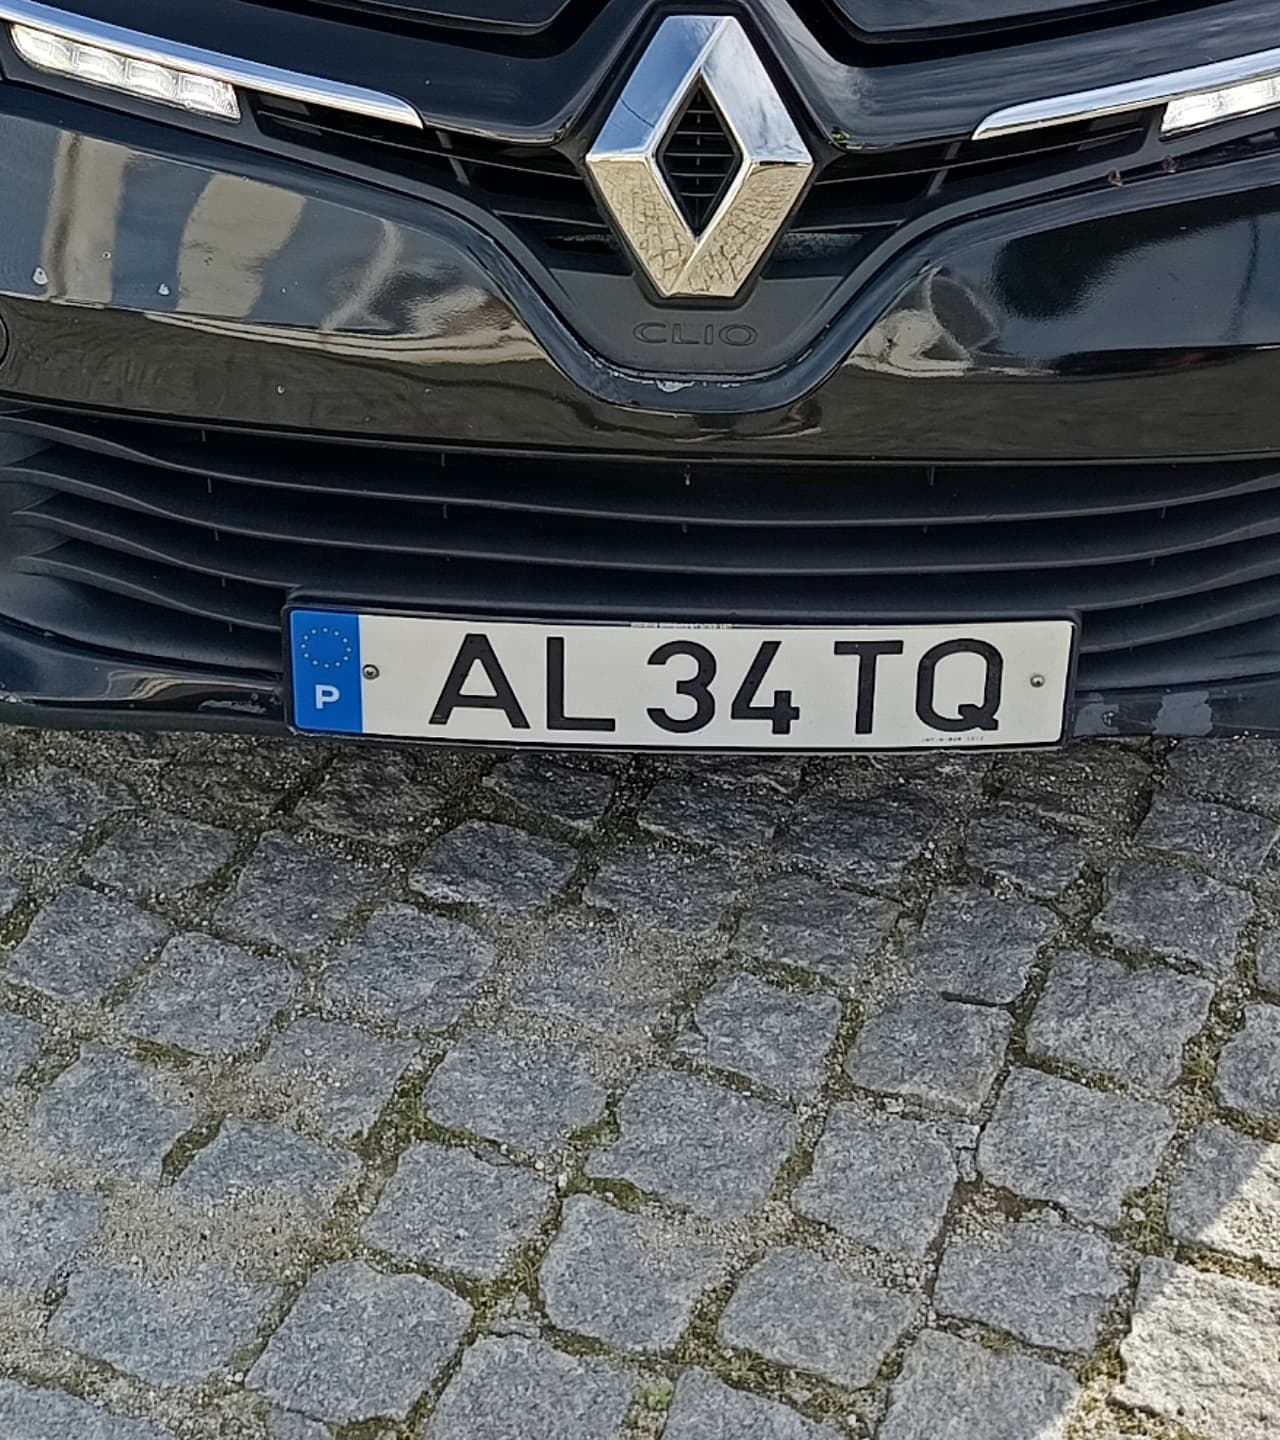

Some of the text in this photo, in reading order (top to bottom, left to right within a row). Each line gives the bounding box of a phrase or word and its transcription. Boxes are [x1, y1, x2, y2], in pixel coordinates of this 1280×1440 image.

[633, 322, 758, 346] CLIO
[315, 684, 340, 709] P
[428, 633, 1003, 735] AL 34 TQ
